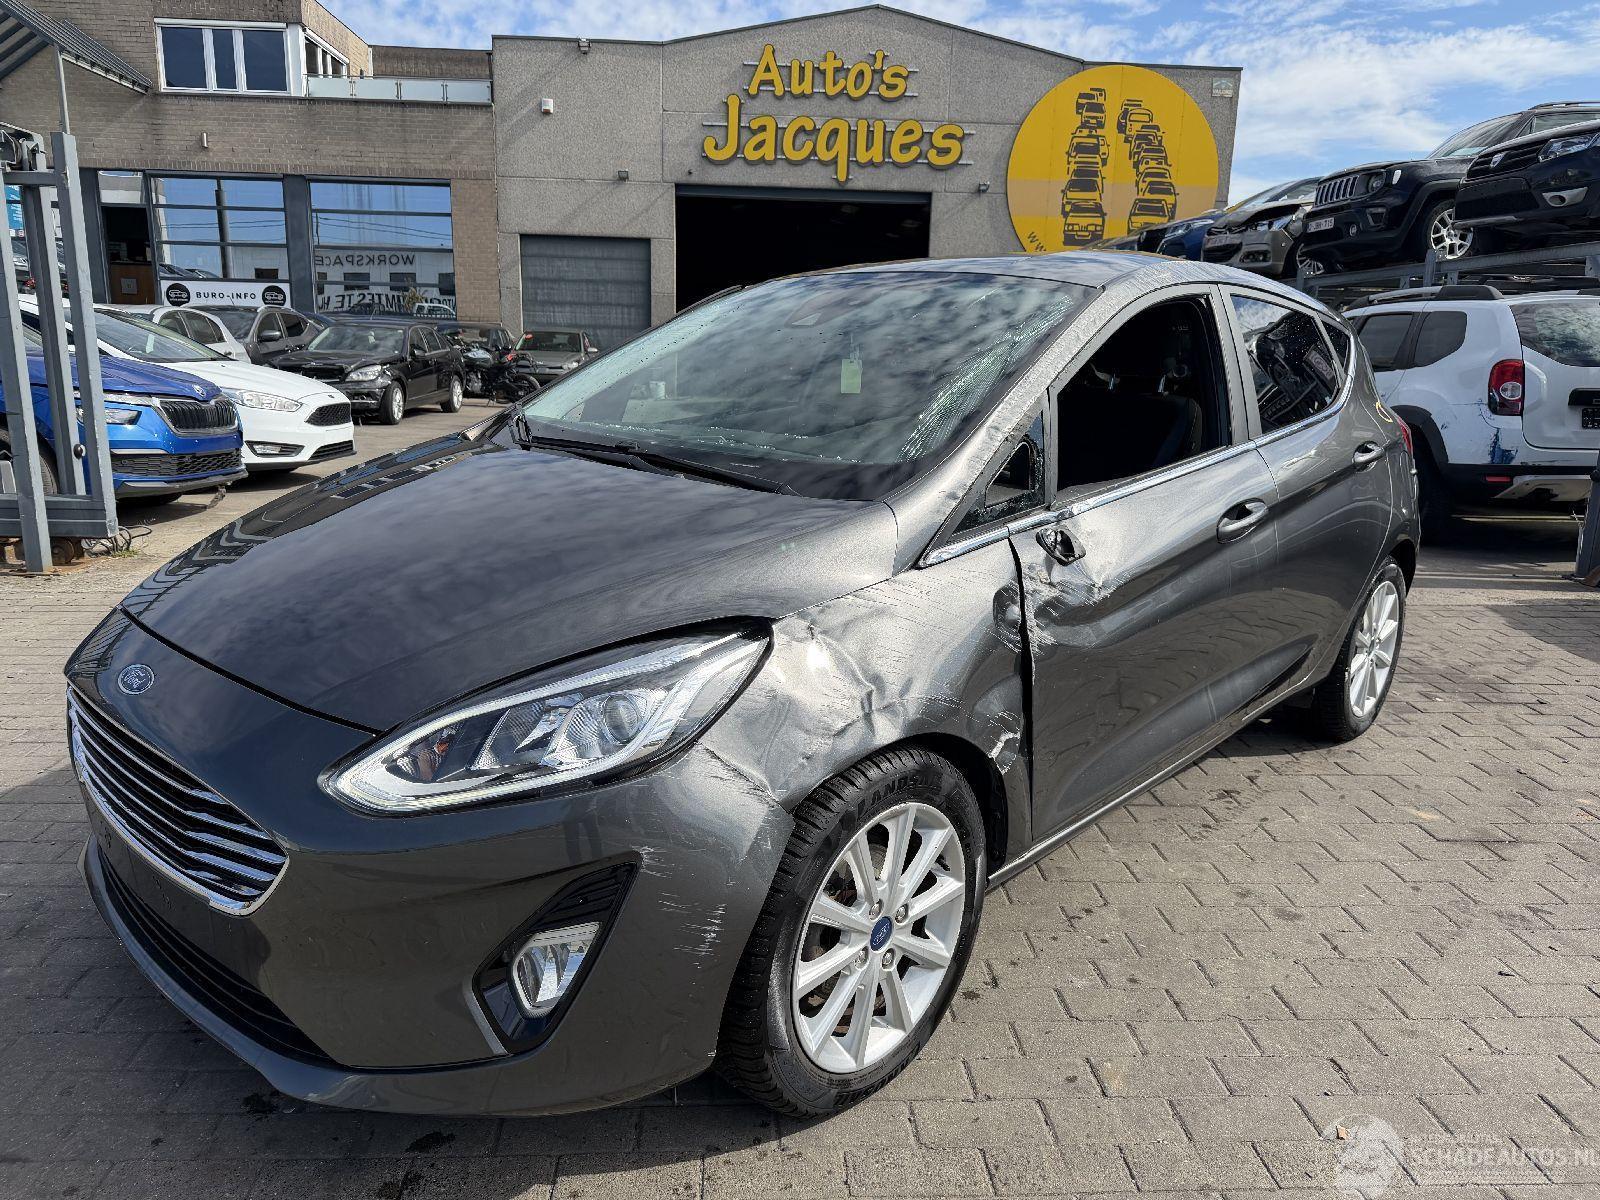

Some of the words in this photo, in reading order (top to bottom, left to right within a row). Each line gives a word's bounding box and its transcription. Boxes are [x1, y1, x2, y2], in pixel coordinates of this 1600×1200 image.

[748, 43, 910, 101] Auto's
[703, 94, 966, 184] Jacques
[196, 291, 257, 300] BURO-INFO
